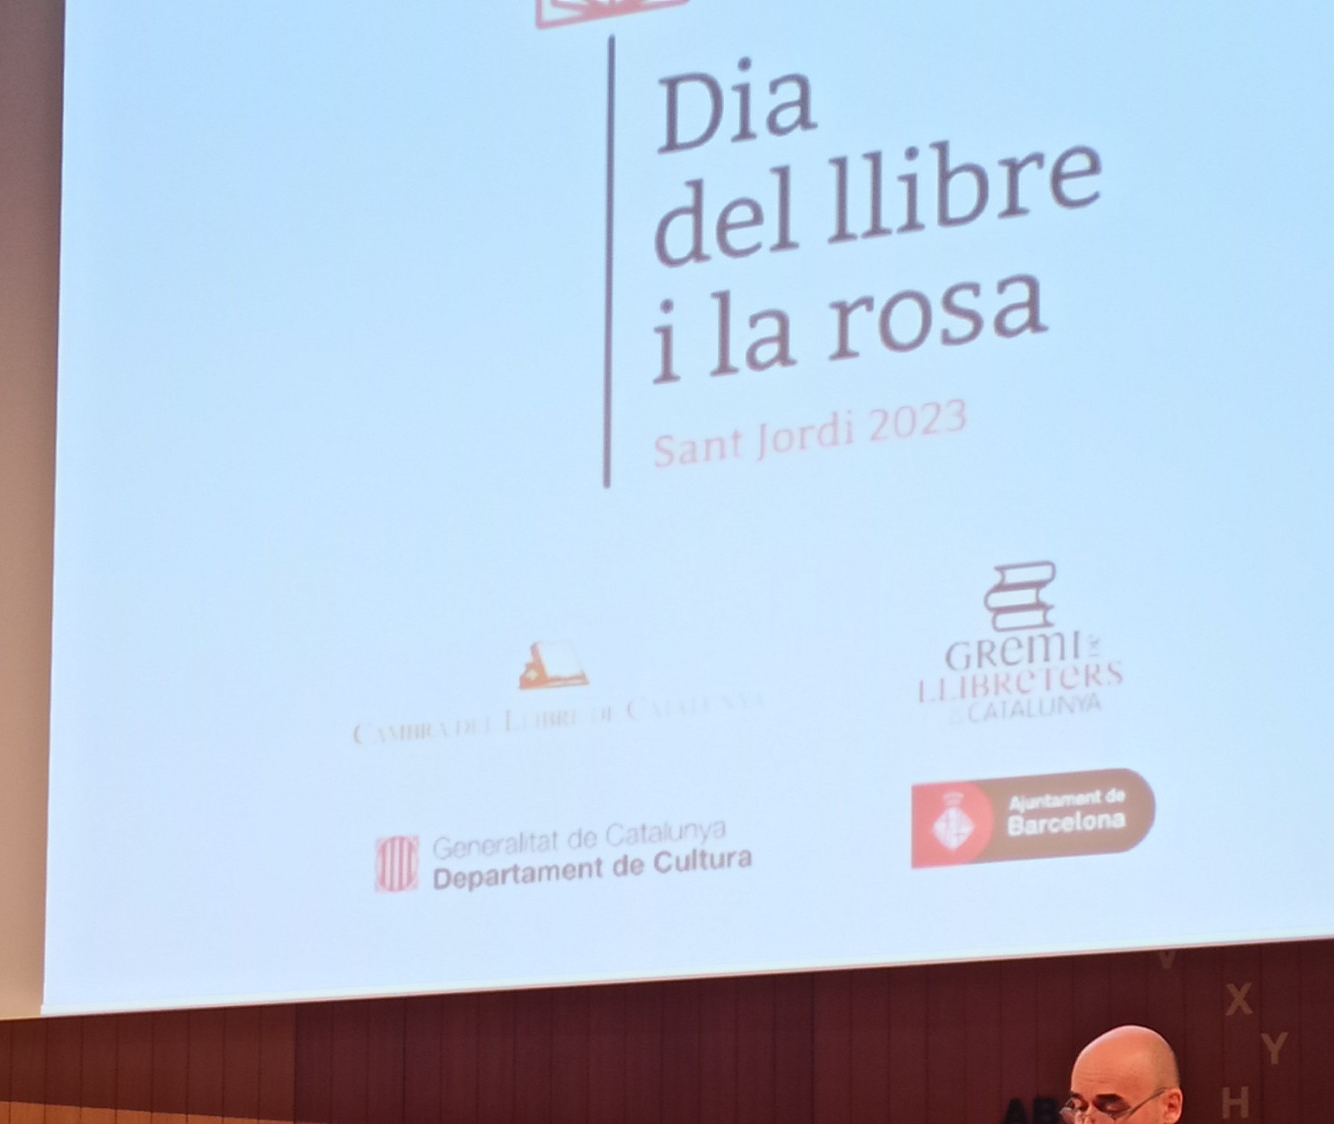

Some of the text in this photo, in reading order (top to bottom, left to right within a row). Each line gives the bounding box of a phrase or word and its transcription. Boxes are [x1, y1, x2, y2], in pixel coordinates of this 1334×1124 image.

[658, 56, 818, 154] Dia
[654, 140, 1103, 269] del llibre
[653, 273, 1049, 386] i la rosa
[653, 398, 968, 469] Sant Jordi 2023
[967, 692, 1103, 724] CATALUNYA
[1008, 787, 1127, 813] Ajuntament de
[433, 819, 727, 861] Generalitat de Catalunya
[1007, 810, 1128, 838] Barcelona
[433, 848, 753, 893] Departament de Cultura
[1225, 982, 1254, 1016] X
[1260, 1031, 1289, 1065] Y
[1221, 1086, 1250, 1120] H
